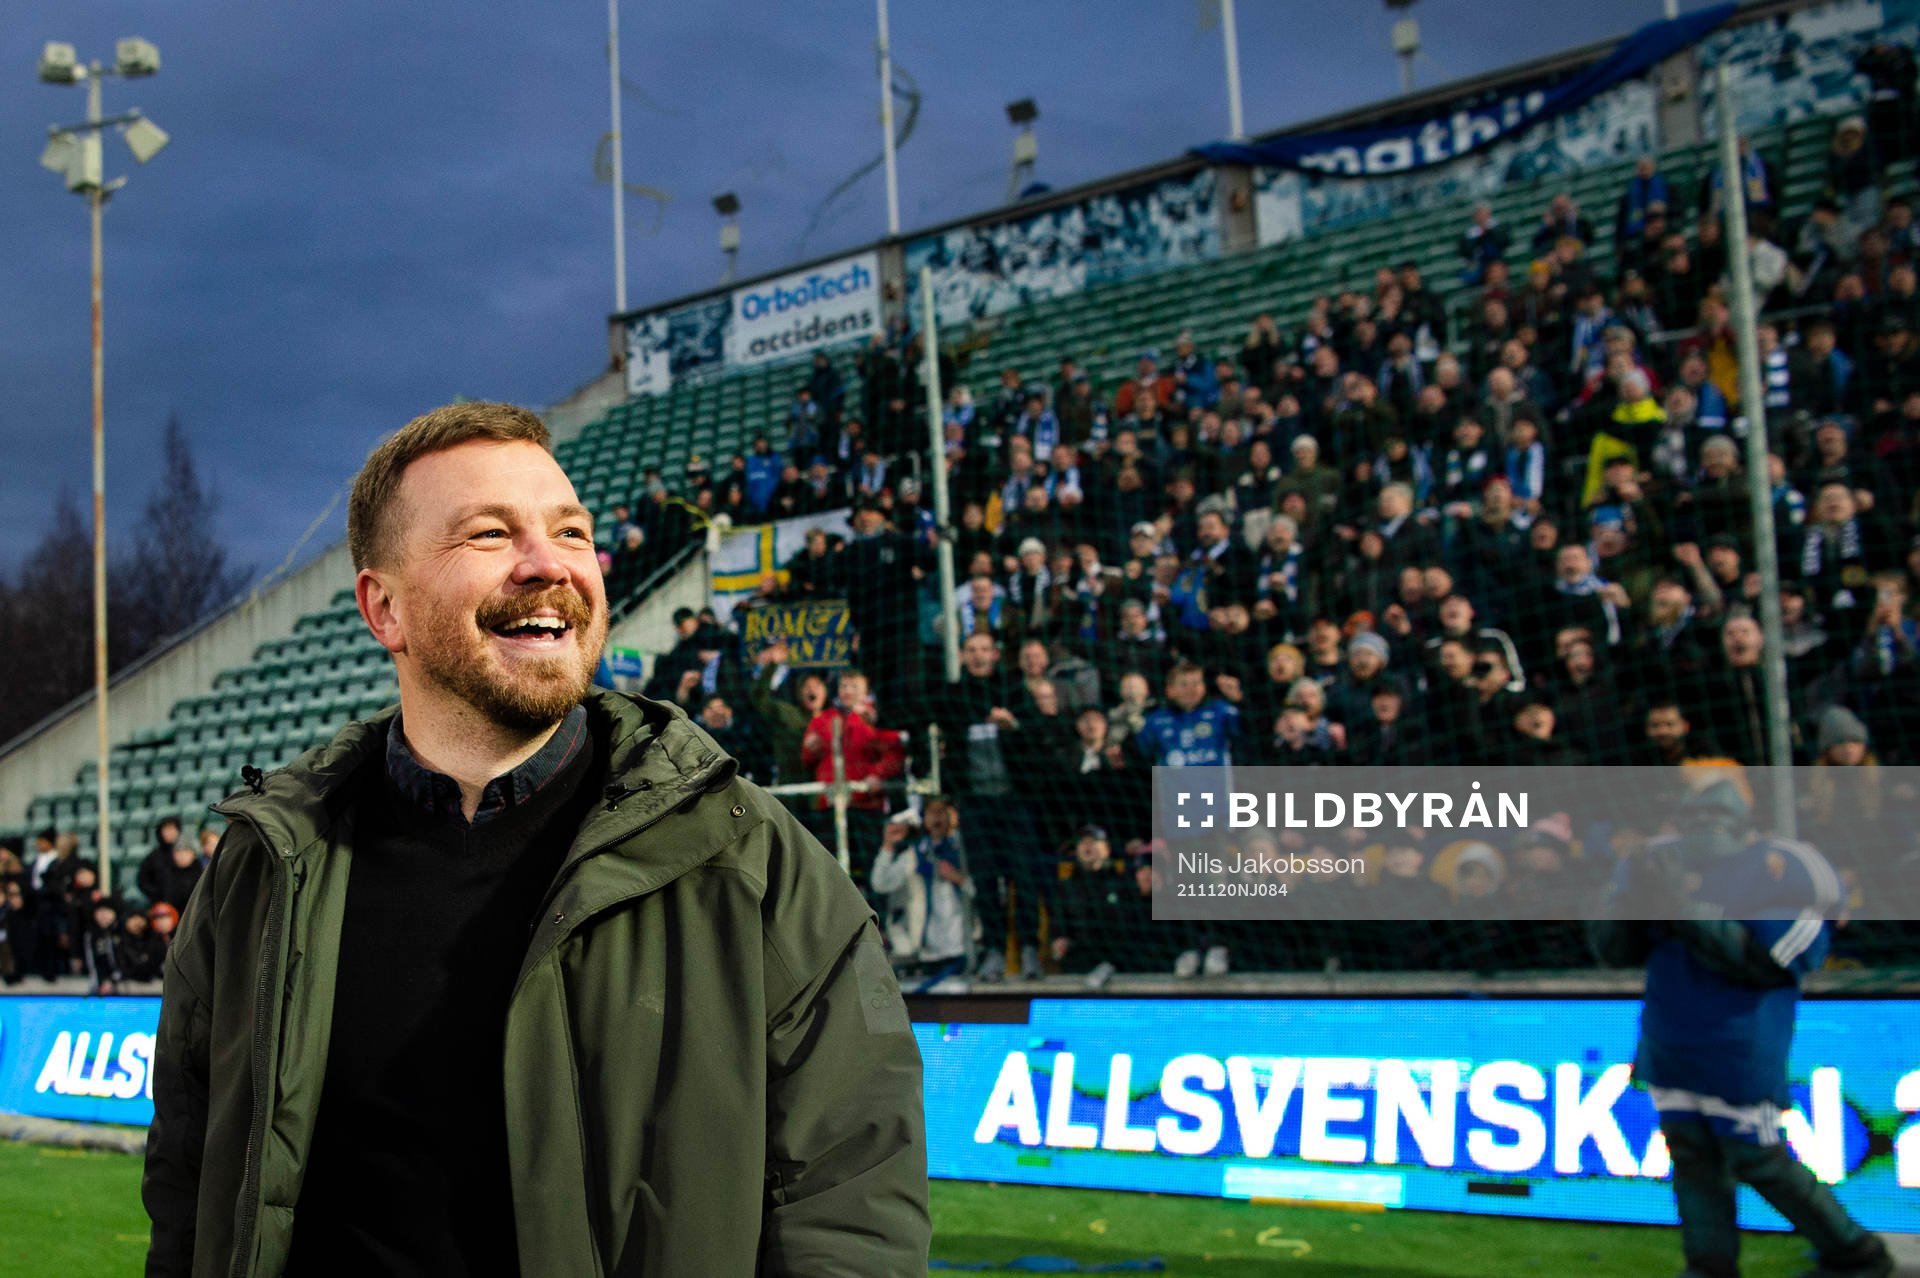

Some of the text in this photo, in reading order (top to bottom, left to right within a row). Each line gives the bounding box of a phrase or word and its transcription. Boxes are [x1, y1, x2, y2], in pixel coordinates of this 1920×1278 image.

[742, 263, 871, 321] OrboTech
[34, 1030, 157, 1100] ALLS
[974, 1051, 1845, 1185] ALLSVENSKN
